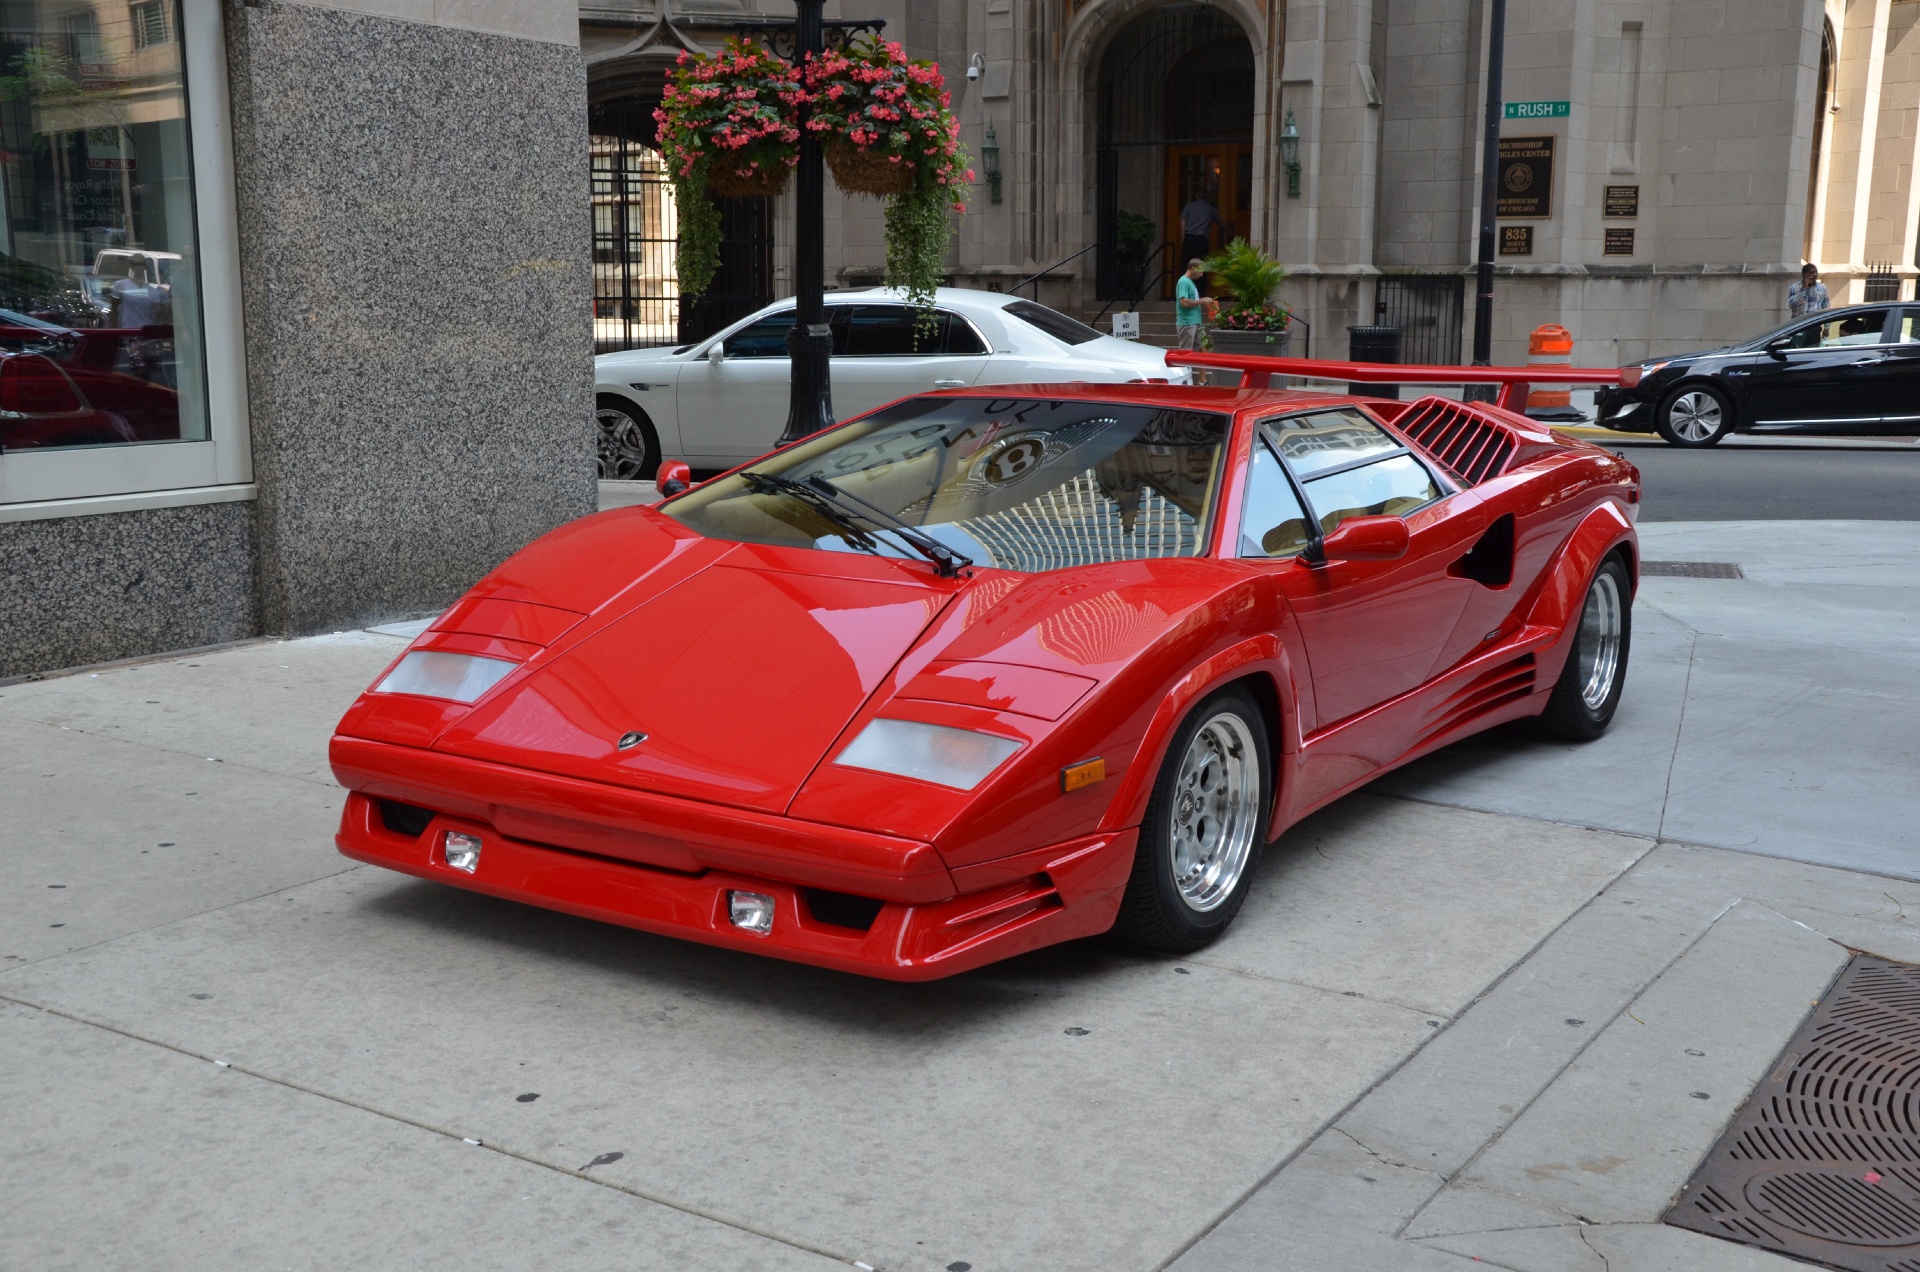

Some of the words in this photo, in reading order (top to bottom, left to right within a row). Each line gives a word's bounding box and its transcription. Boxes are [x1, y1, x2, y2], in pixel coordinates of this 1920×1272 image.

[83, 65, 98, 73] TOW
[1509, 106, 1514, 114] N
[1518, 103, 1553, 116] RUSH
[1558, 104, 1566, 113] ST
[1498, 141, 1543, 149] ARCHBISHOP
[1498, 150, 1521, 158] IGLEY
[89, 159, 106, 168] TOW
[110, 160, 131, 169] ZONE
[1506, 228, 1527, 240] 835
